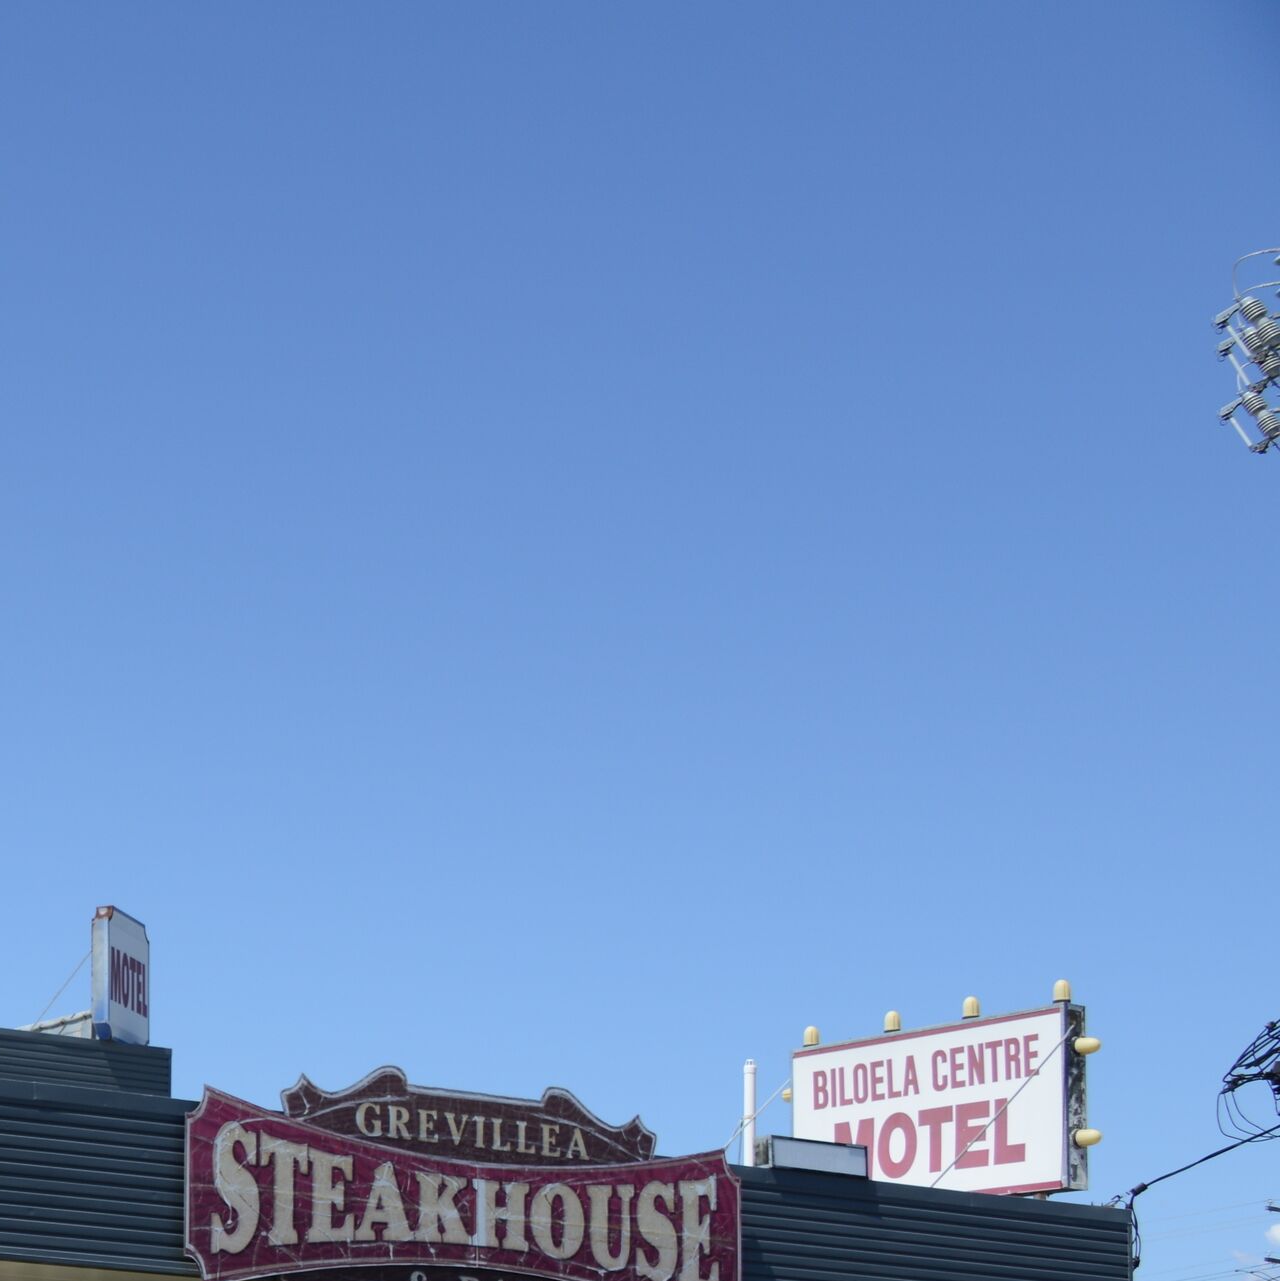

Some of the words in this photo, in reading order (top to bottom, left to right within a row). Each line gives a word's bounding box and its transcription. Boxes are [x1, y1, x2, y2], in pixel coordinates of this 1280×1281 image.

[110, 946, 148, 1018] MOTEL
[813, 1055, 920, 1111] BILOELA
[931, 1033, 1040, 1092] CENTRE
[355, 1101, 591, 1162] GREVILLEA
